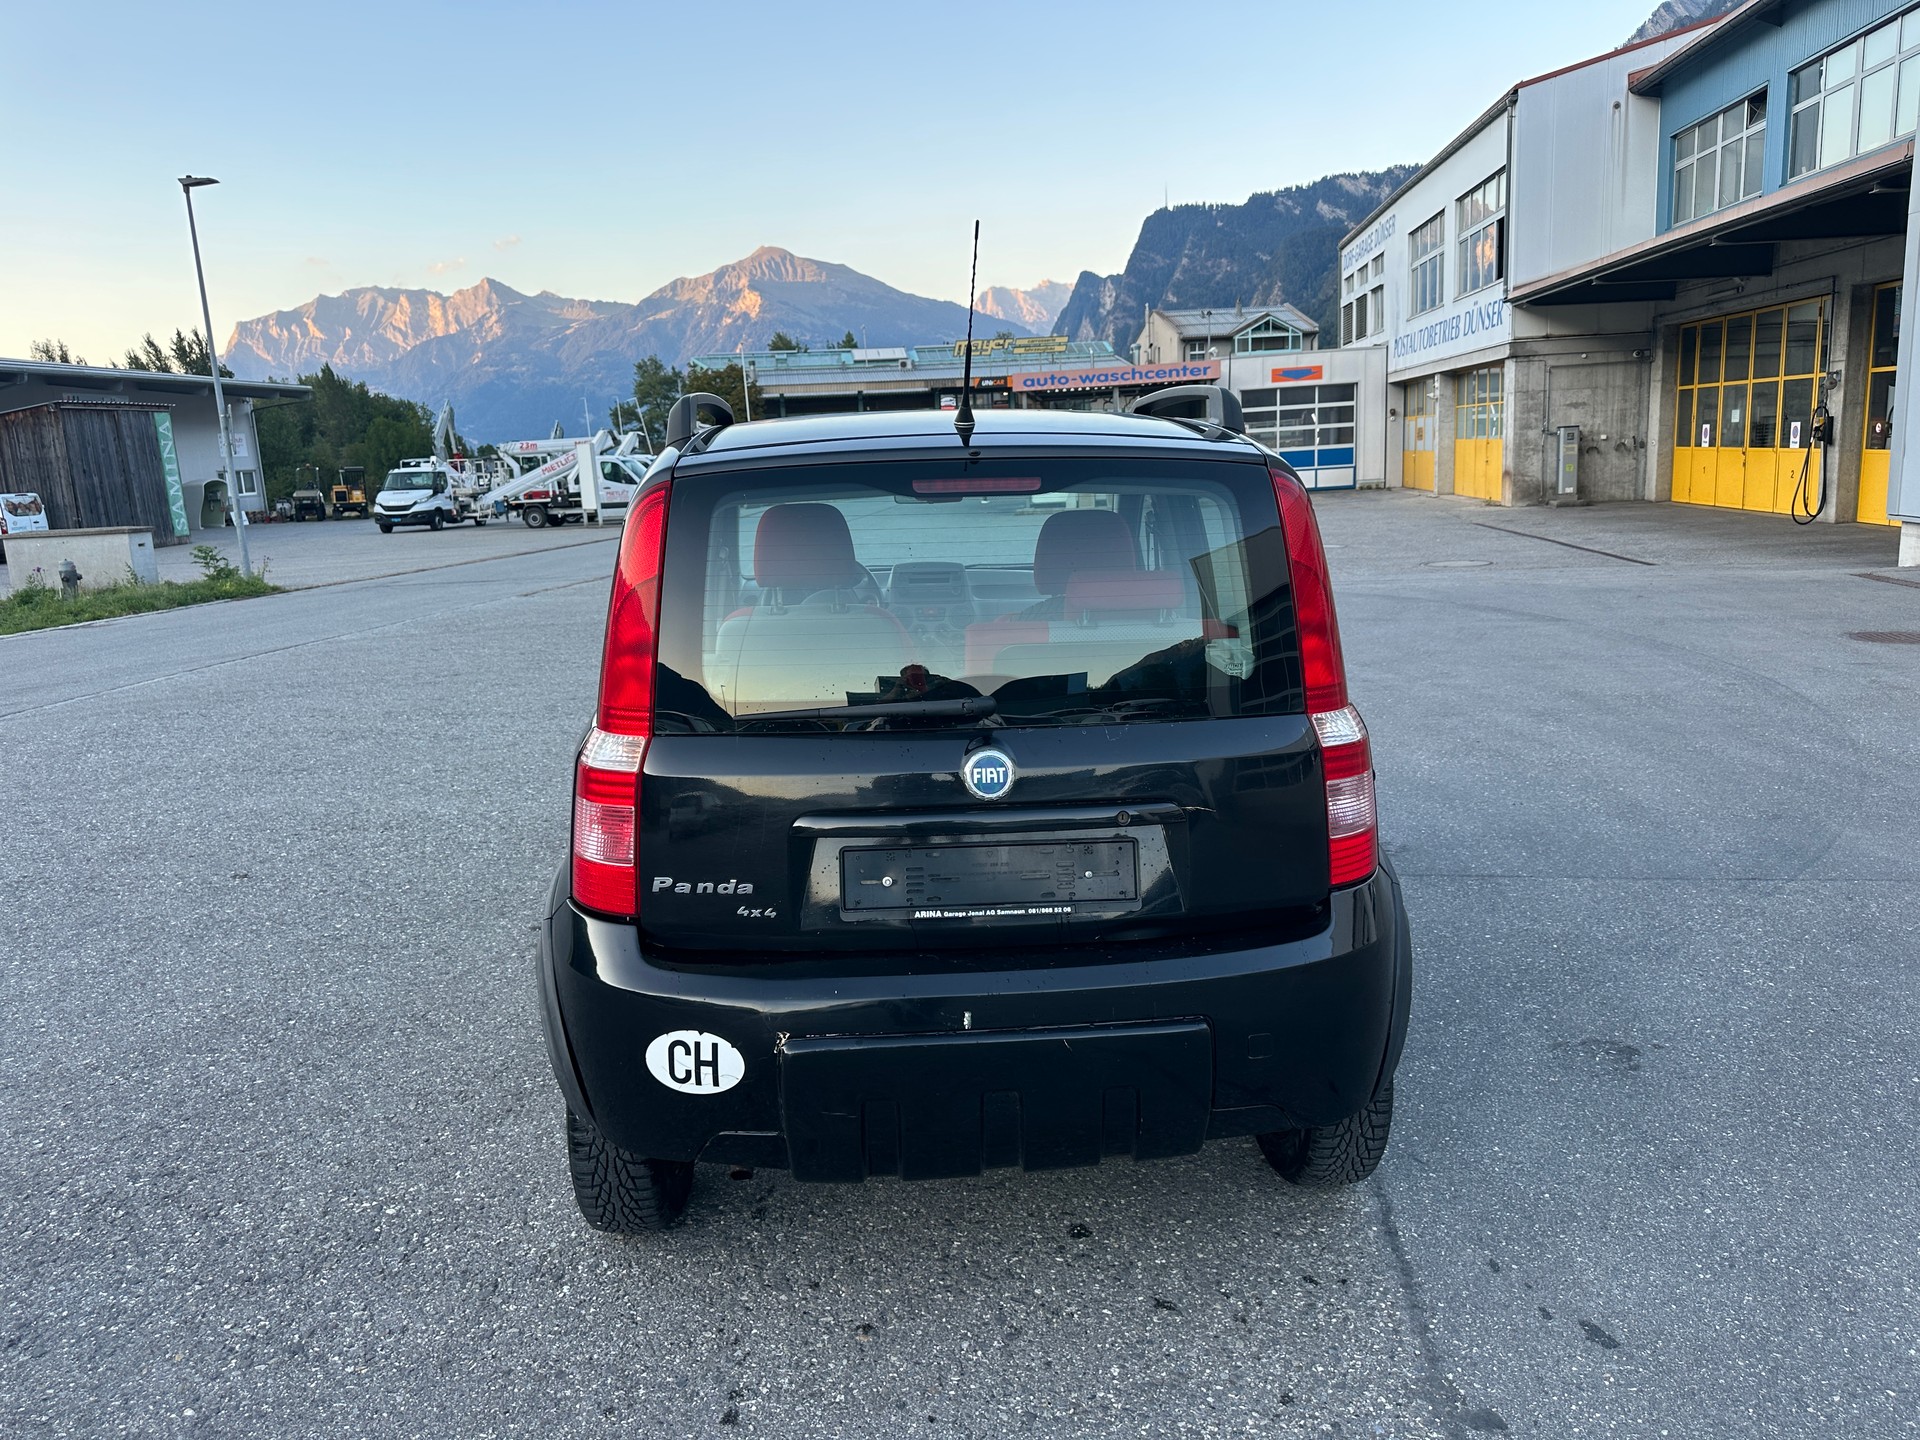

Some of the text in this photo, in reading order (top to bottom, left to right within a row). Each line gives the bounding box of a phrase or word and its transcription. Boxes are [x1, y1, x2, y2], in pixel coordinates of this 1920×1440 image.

[1393, 300, 1504, 358] POSTAUTOBETRIEB DÜNSER
[1022, 365, 1212, 388] auto-waschcenter
[519, 442, 538, 451] 23m
[158, 421, 187, 530] SAMINA
[1790, 470, 1795, 479] 2
[973, 767, 1006, 784] FIAT
[651, 876, 754, 895] Panda
[736, 905, 777, 918] 4x4
[914, 910, 942, 918] ARINA
[996, 908, 1026, 916] Samnaun
[668, 1039, 720, 1087] CH
